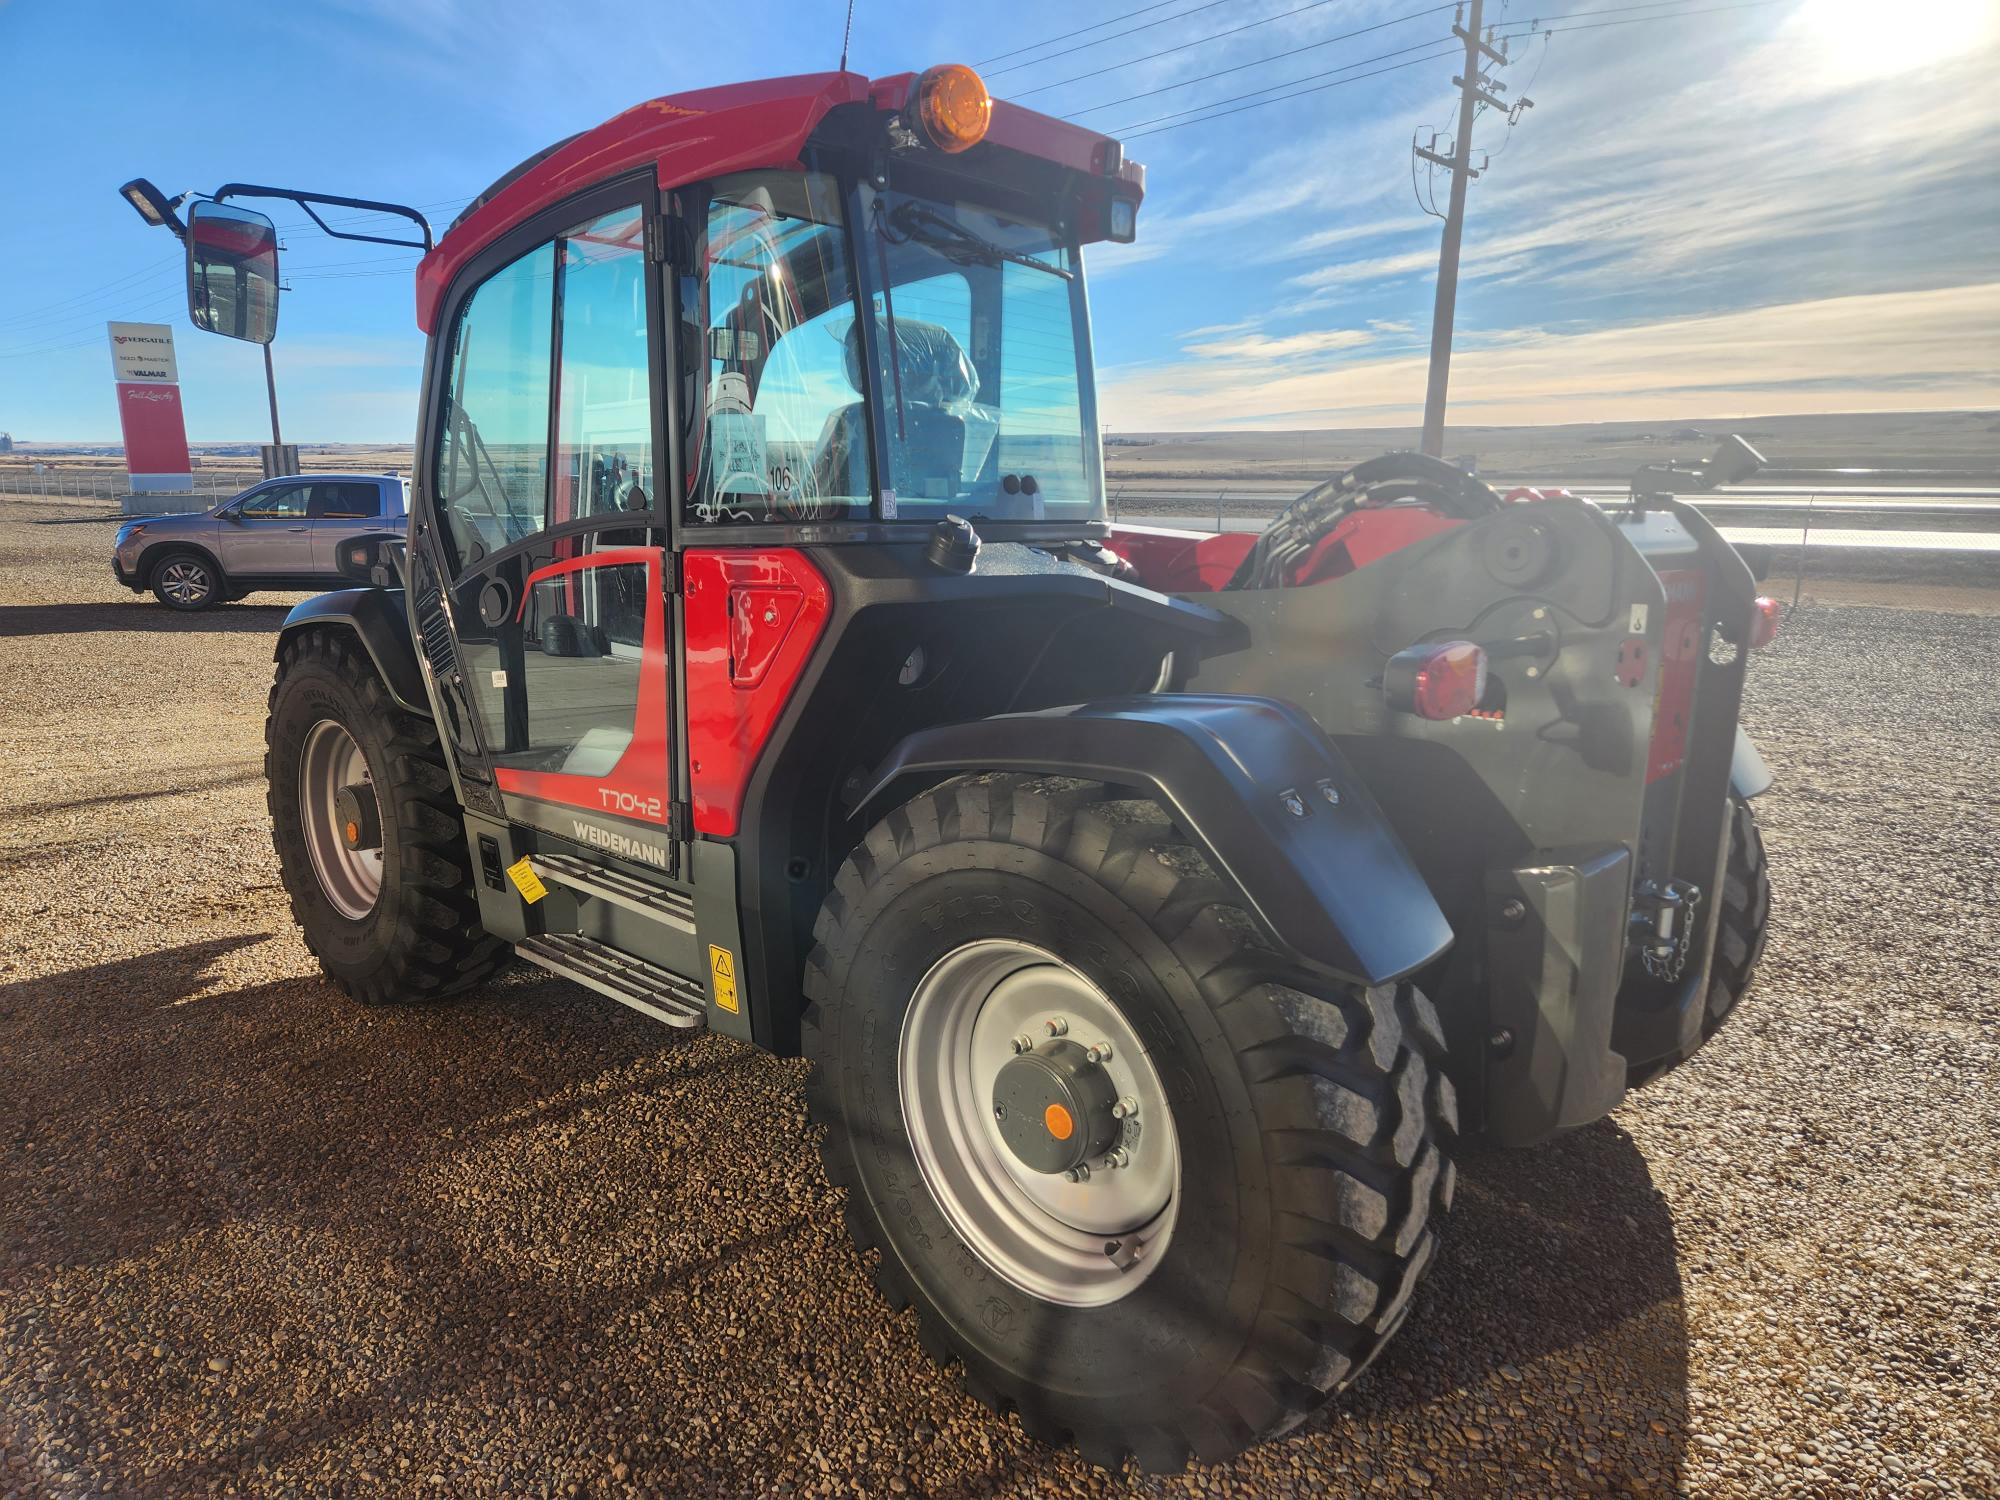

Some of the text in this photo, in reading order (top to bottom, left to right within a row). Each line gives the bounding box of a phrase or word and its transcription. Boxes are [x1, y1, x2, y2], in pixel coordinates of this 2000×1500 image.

[127, 336, 172, 345] VERSATILE
[133, 370, 167, 378] VALMAR
[770, 466, 791, 491] 106
[598, 787, 662, 818] T7042
[573, 820, 666, 867] WEIDEMANN
